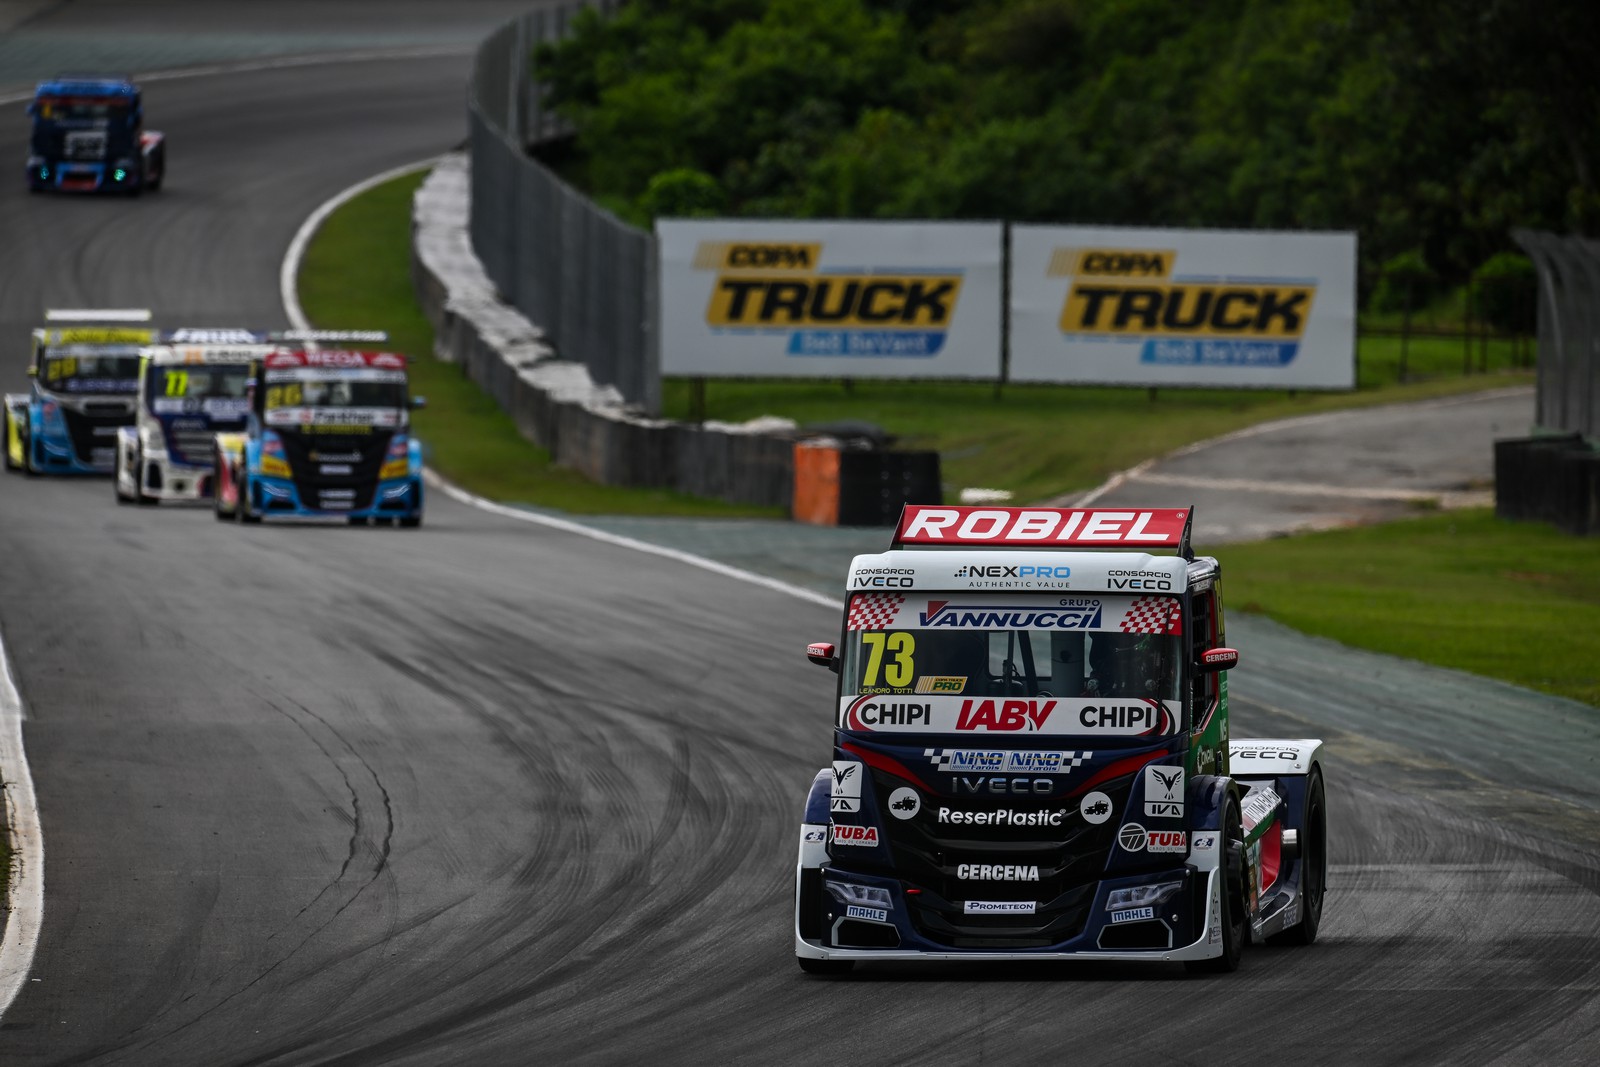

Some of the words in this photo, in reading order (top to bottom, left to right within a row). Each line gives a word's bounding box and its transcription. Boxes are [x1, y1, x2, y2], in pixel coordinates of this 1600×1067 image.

[727, 245, 811, 268] COPA
[1082, 252, 1164, 275] COPA
[721, 280, 955, 323] TRUCK
[1075, 288, 1307, 333] TRUCK
[165, 370, 188, 397] 77
[903, 509, 1170, 541] ROBIEL
[855, 567, 914, 576] CONSÓRCIO
[970, 566, 1071, 578] NEXPRO
[1108, 570, 1172, 579] CONSÓRCIO
[853, 577, 914, 588] IVECO
[1107, 579, 1171, 591] IVECO
[1059, 599, 1100, 607] GRUPO
[862, 632, 915, 688] 73
[1205, 652, 1237, 663] CERCENA
[933, 682, 962, 691] PRO
[952, 777, 1053, 794] IVECO
[938, 807, 1062, 826] ReserPlastic
[835, 826, 877, 841] TUBA
[1148, 833, 1186, 847] TUBA
[957, 864, 1040, 881] CERCENA
[848, 907, 885, 920] MAHLE
[1113, 909, 1151, 921] MAHLE
